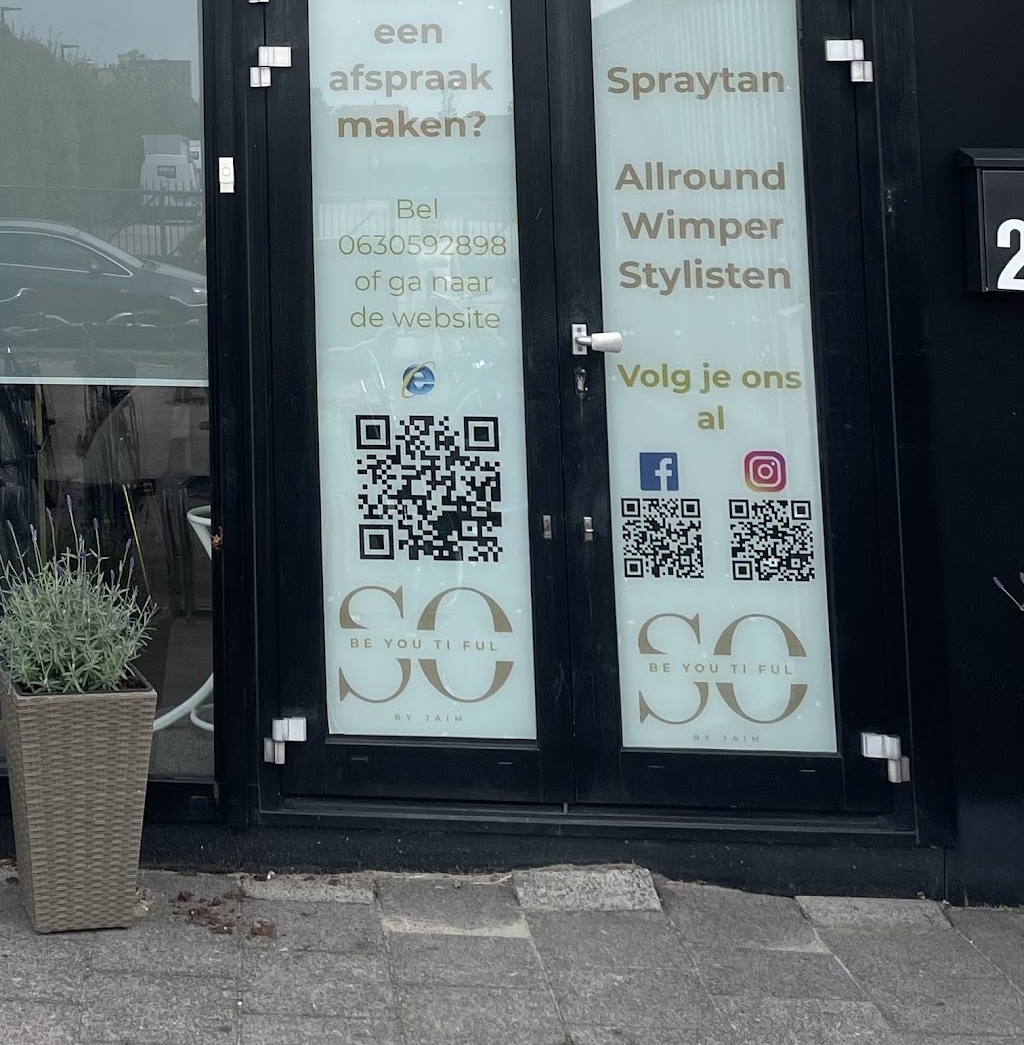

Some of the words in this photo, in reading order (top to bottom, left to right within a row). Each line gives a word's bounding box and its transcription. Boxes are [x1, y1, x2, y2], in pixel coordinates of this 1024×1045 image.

[373, 22, 443, 45] een
[328, 62, 494, 98] afspraak
[606, 65, 786, 101] Spraytan
[336, 109, 487, 139] maken?
[614, 161, 787, 192] Allround
[396, 197, 439, 220] Bel
[621, 209, 784, 247] Wimper
[338, 234, 507, 257] 0630592898
[996, 218, 1024, 291] 2
[354, 270, 382, 293] of
[388, 275, 423, 298] ga
[432, 275, 494, 294] naar
[618, 258, 792, 297] Stylisten
[349, 305, 385, 329] de
[391, 306, 502, 330] website
[617, 363, 692, 395] Volg
[699, 362, 732, 395] je
[741, 367, 803, 391] ons
[696, 404, 726, 431] al
[338, 585, 515, 704] SO
[350, 638, 373, 649] BE
[384, 638, 423, 650] YOU
[433, 639, 451, 651] TI
[462, 640, 499, 652] FUL
[637, 612, 809, 726] SO
[648, 662, 672, 674] BE
[681, 662, 720, 675] YOU
[729, 663, 747, 675] TI
[758, 664, 793, 676] FUL
[394, 713, 412, 722] BY
[425, 714, 464, 723] JAIM
[693, 734, 710, 743] BY
[722, 734, 760, 744] JAIM
